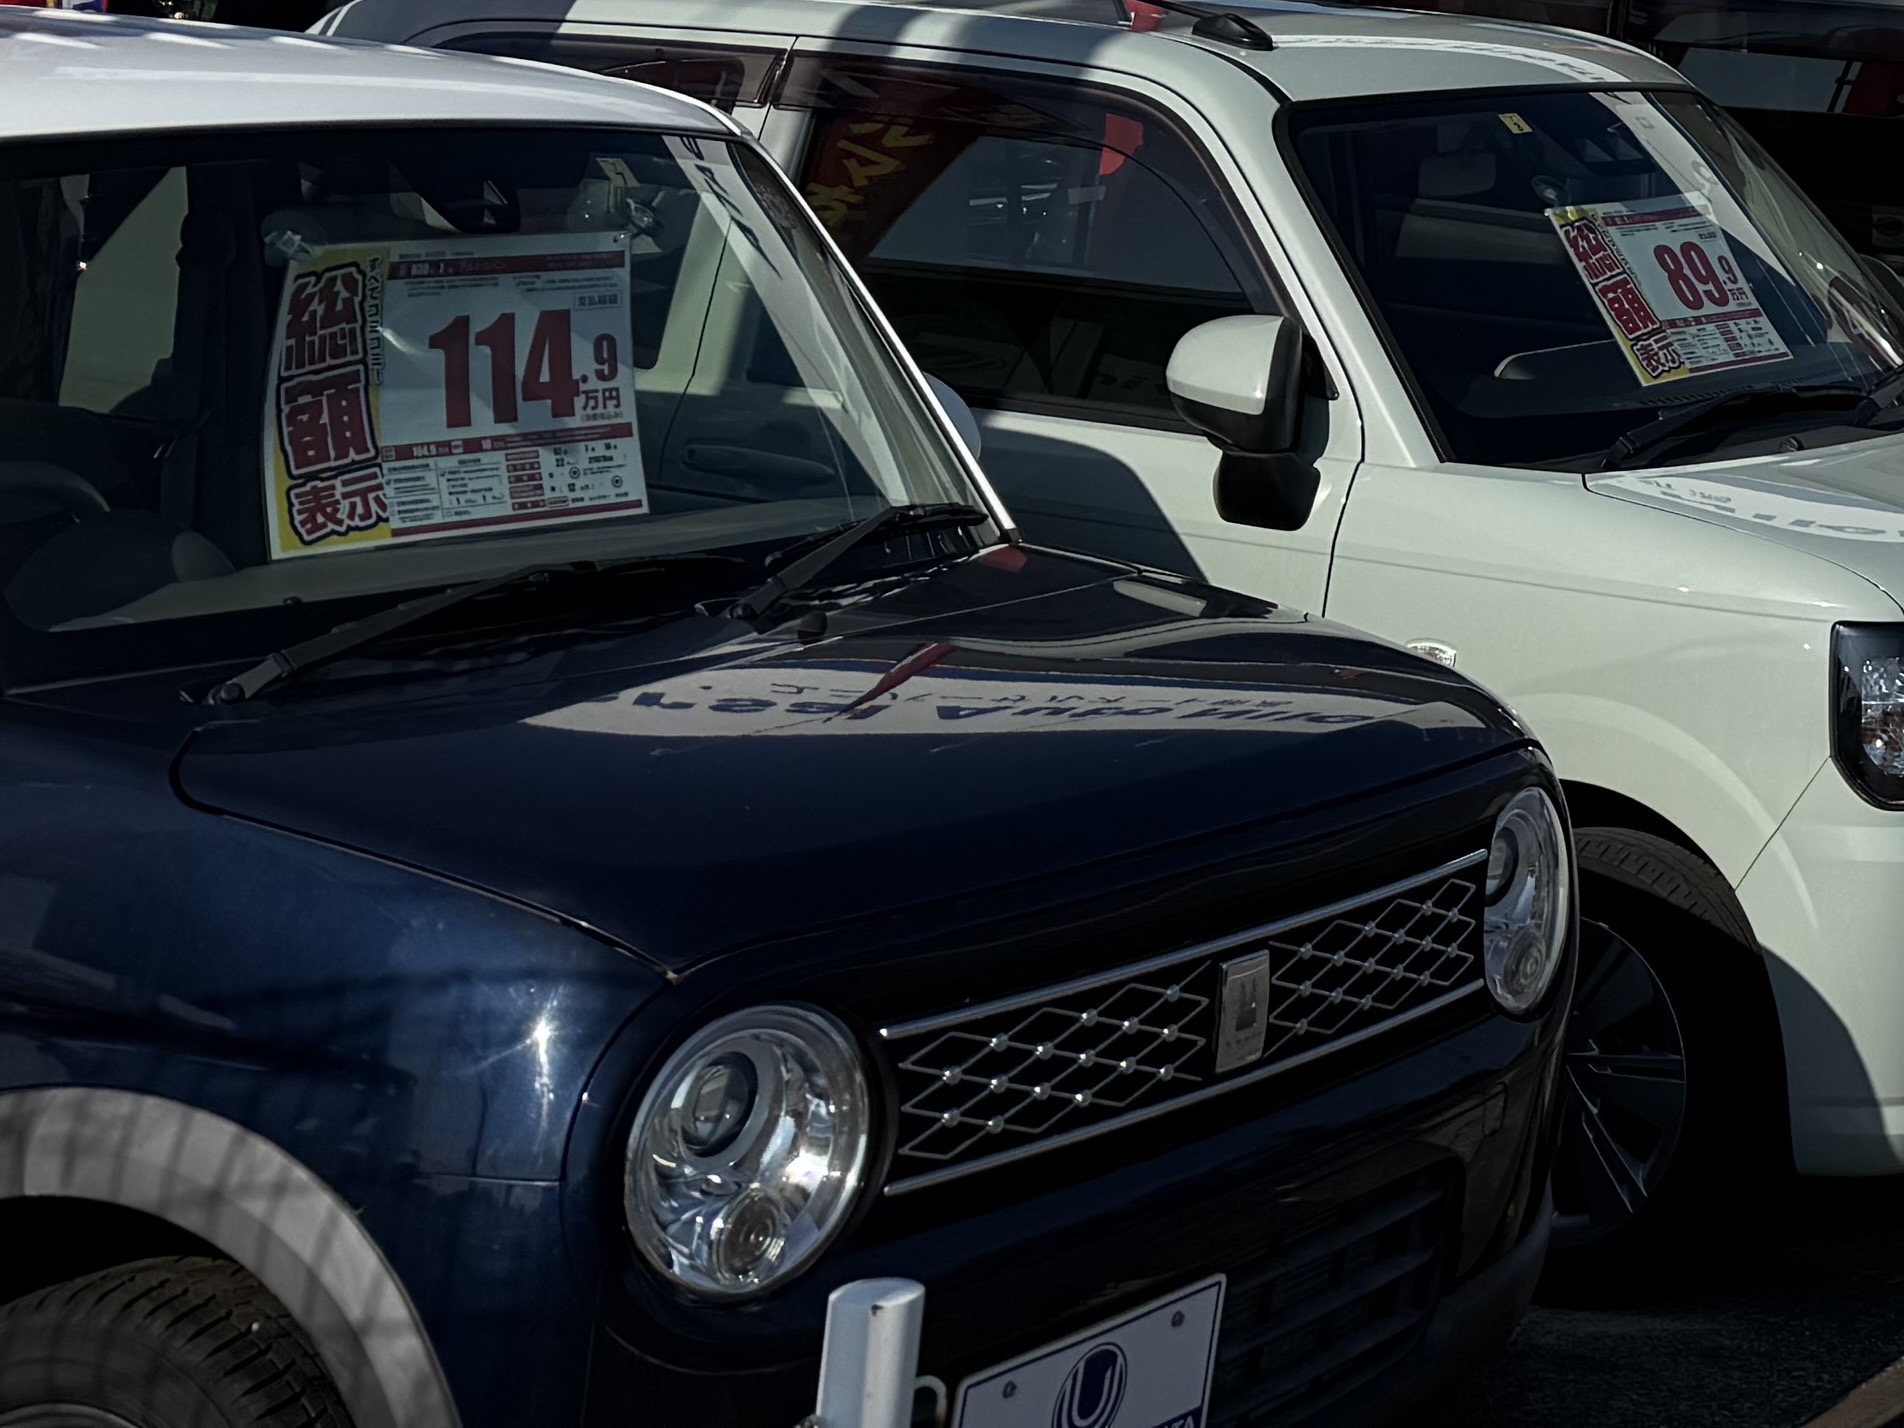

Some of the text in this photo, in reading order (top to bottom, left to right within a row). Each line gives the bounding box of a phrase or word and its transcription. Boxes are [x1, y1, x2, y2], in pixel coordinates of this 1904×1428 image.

[1653, 241, 1739, 311] 89.9
[428, 309, 619, 428] 114.9
[580, 387, 621, 411] 万円
[293, 470, 390, 537] 表示
